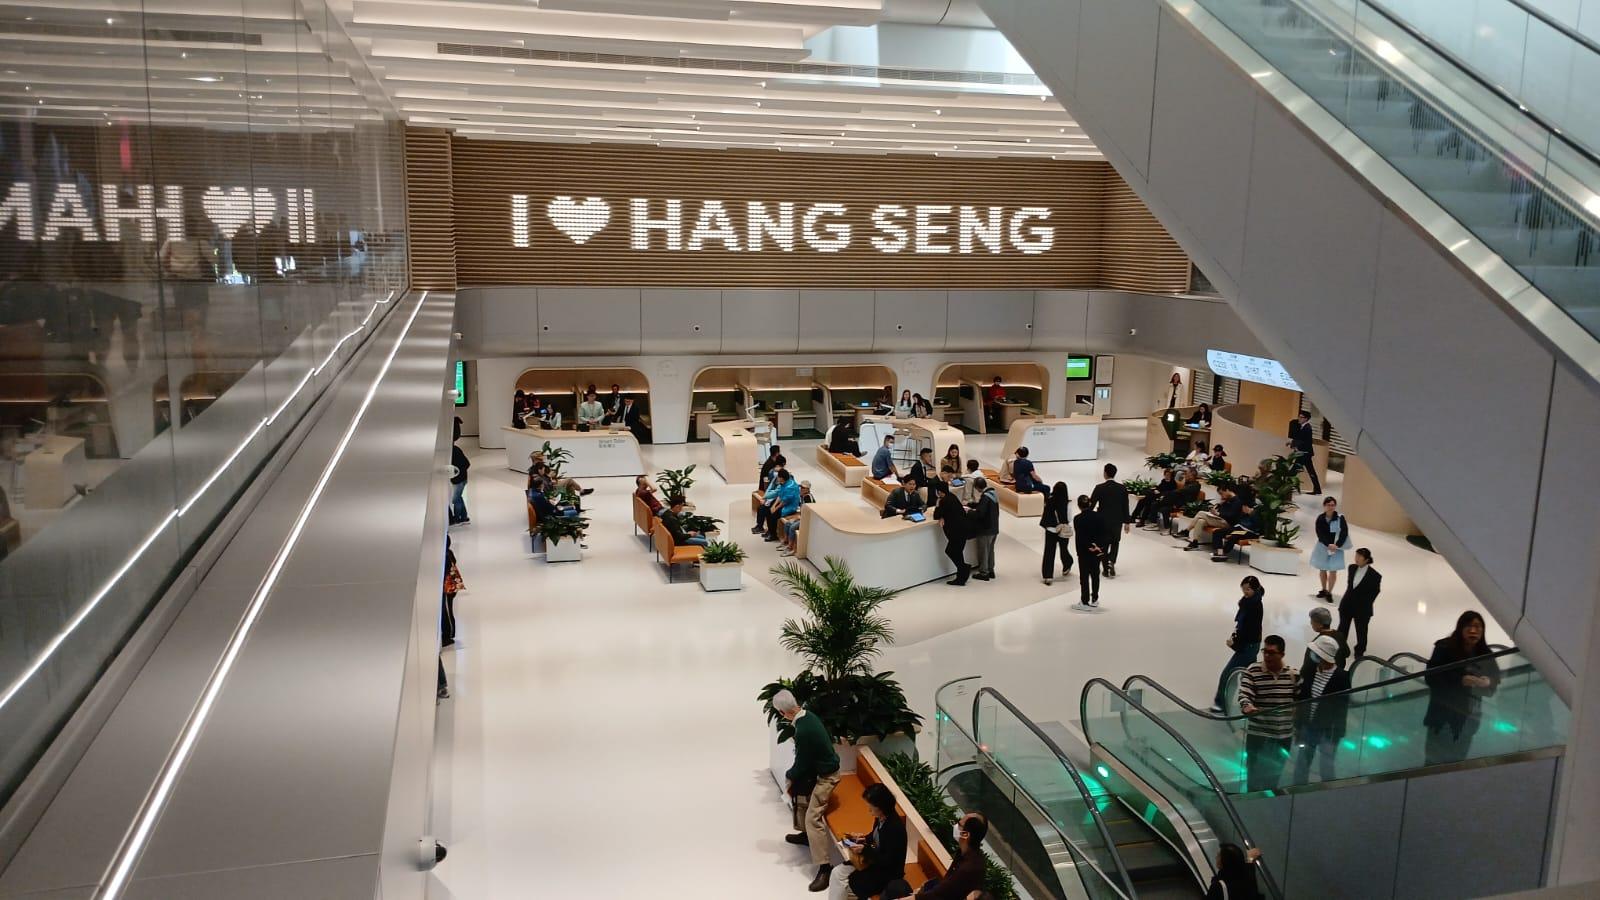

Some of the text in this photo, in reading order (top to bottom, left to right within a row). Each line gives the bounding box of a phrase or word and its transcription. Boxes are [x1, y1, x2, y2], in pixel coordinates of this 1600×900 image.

[510, 194, 1054, 253] I HANG SENG
